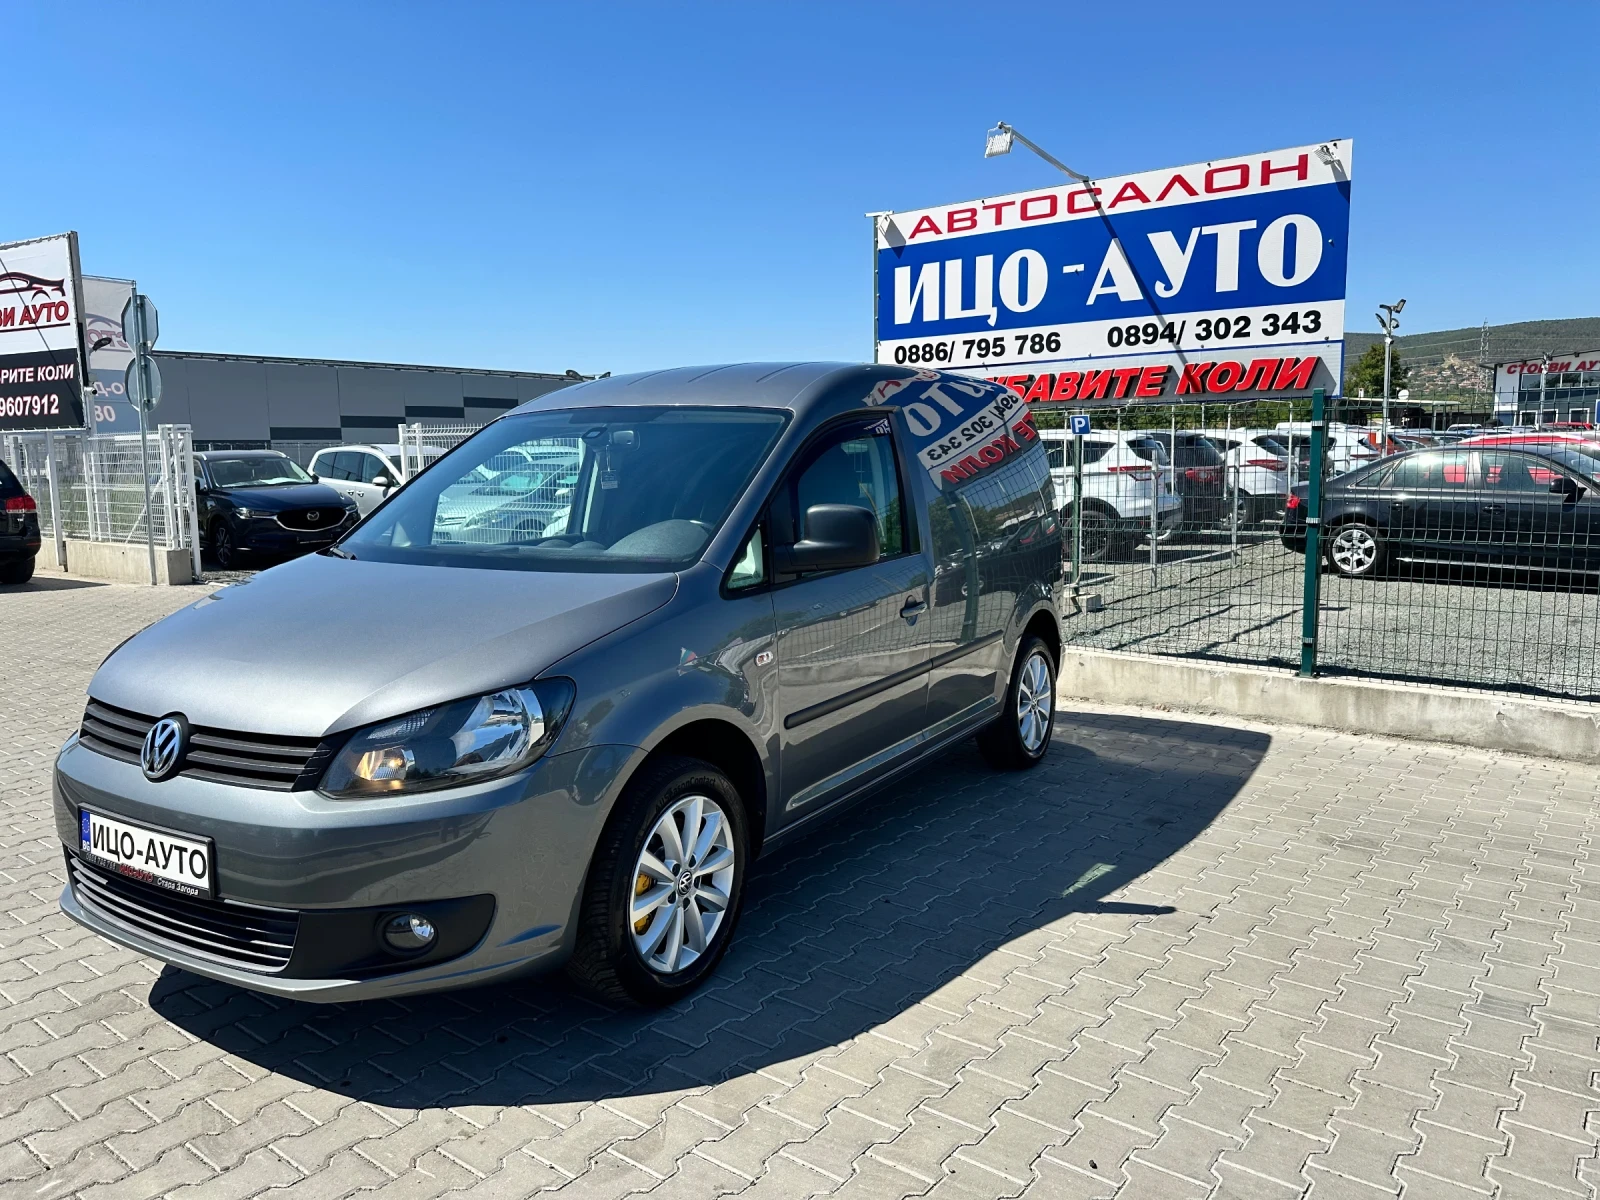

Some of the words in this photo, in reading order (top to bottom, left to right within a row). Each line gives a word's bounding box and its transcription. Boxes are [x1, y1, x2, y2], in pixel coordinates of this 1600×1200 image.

[909, 154, 1309, 240] АВТОСАЛОН
[19, 301, 69, 325] АУТО
[1107, 319, 1187, 349] 0894/
[1194, 316, 1251, 342] 302
[1262, 310, 1322, 336] 343
[894, 341, 955, 364] 0886/
[962, 337, 1006, 360] 795
[1015, 332, 1061, 356] 786
[37, 364, 74, 381] КОЛИ
[1174, 356, 1322, 396] КОЛИ
[1507, 362, 1571, 375] СТОВИ
[1575, 360, 1600, 371] АУ
[1075, 418, 1086, 433] P
[82, 840, 91, 851] BG
[92, 822, 207, 880] ИЦО-АУТО
